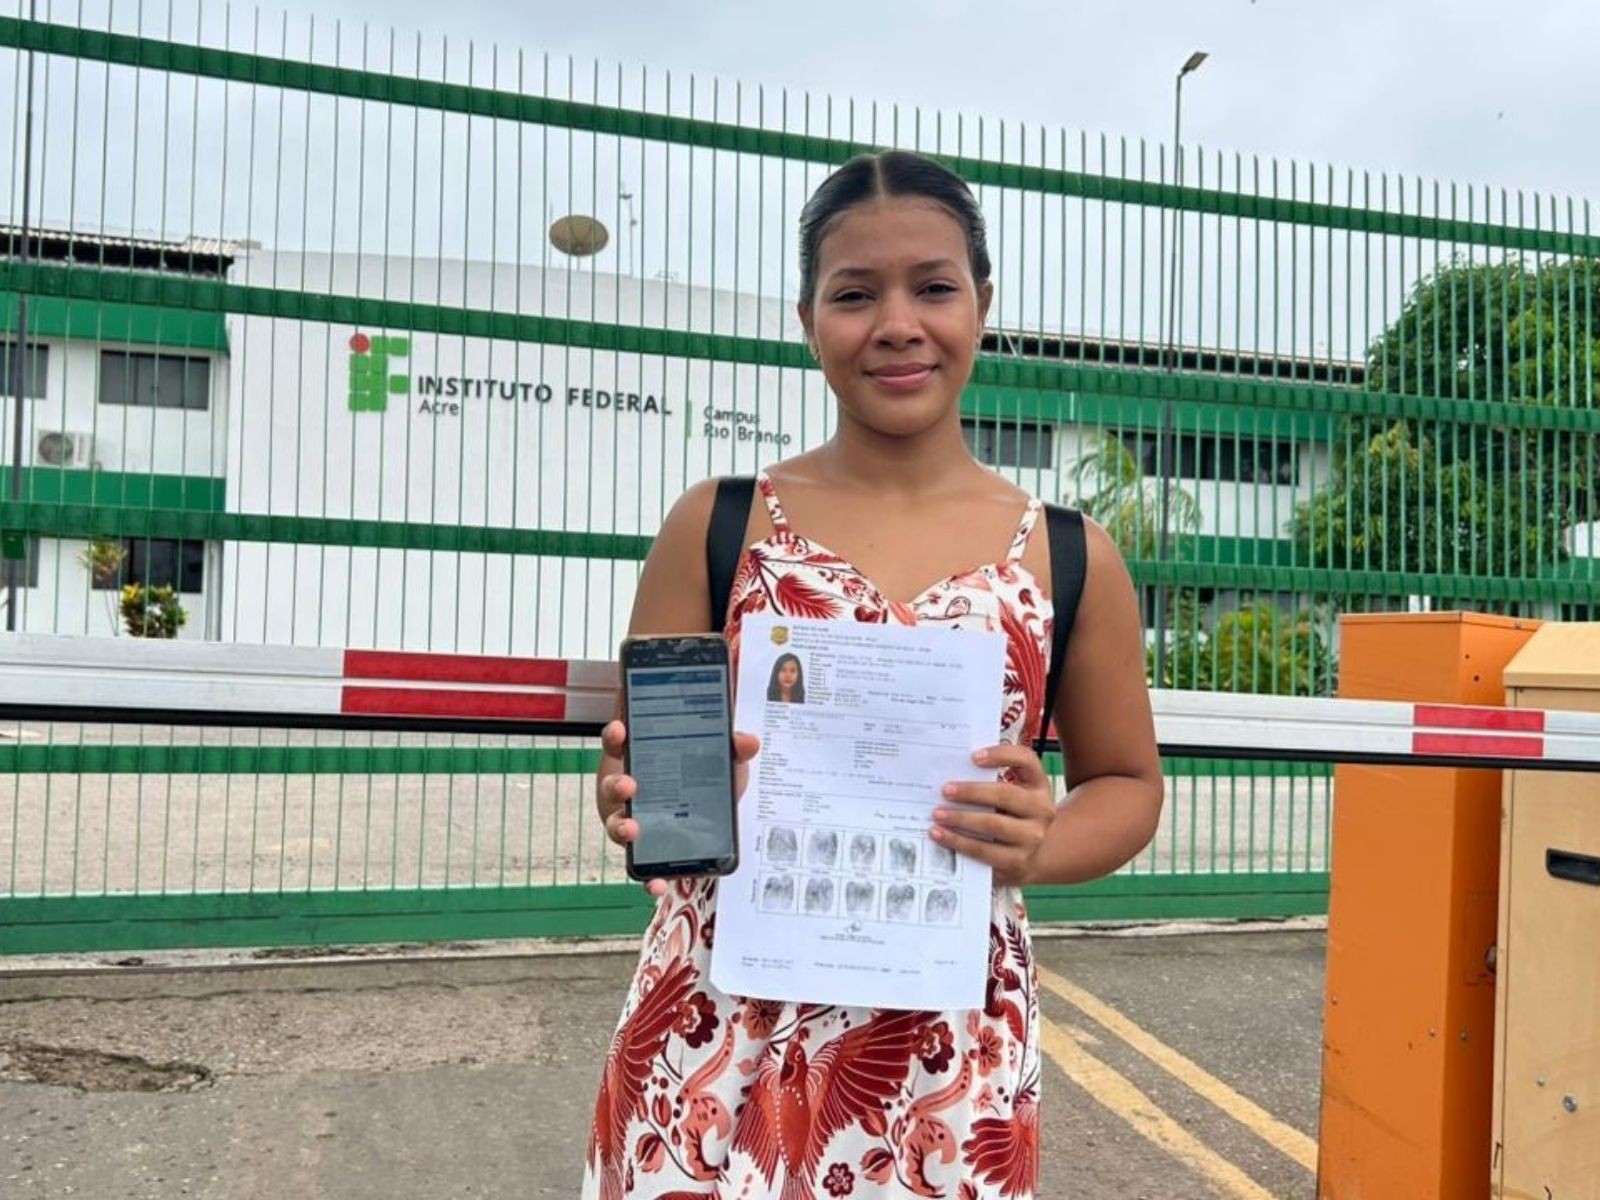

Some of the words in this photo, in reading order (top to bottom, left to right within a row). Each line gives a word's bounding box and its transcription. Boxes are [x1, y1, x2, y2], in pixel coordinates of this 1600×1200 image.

[417, 376, 553, 403] INSTITUTO
[567, 387, 673, 415] FEDERAL
[418, 401, 460, 415] Acre
[703, 406, 761, 426] Campus
[703, 423, 730, 439] Rio
[737, 425, 791, 445] Branco
